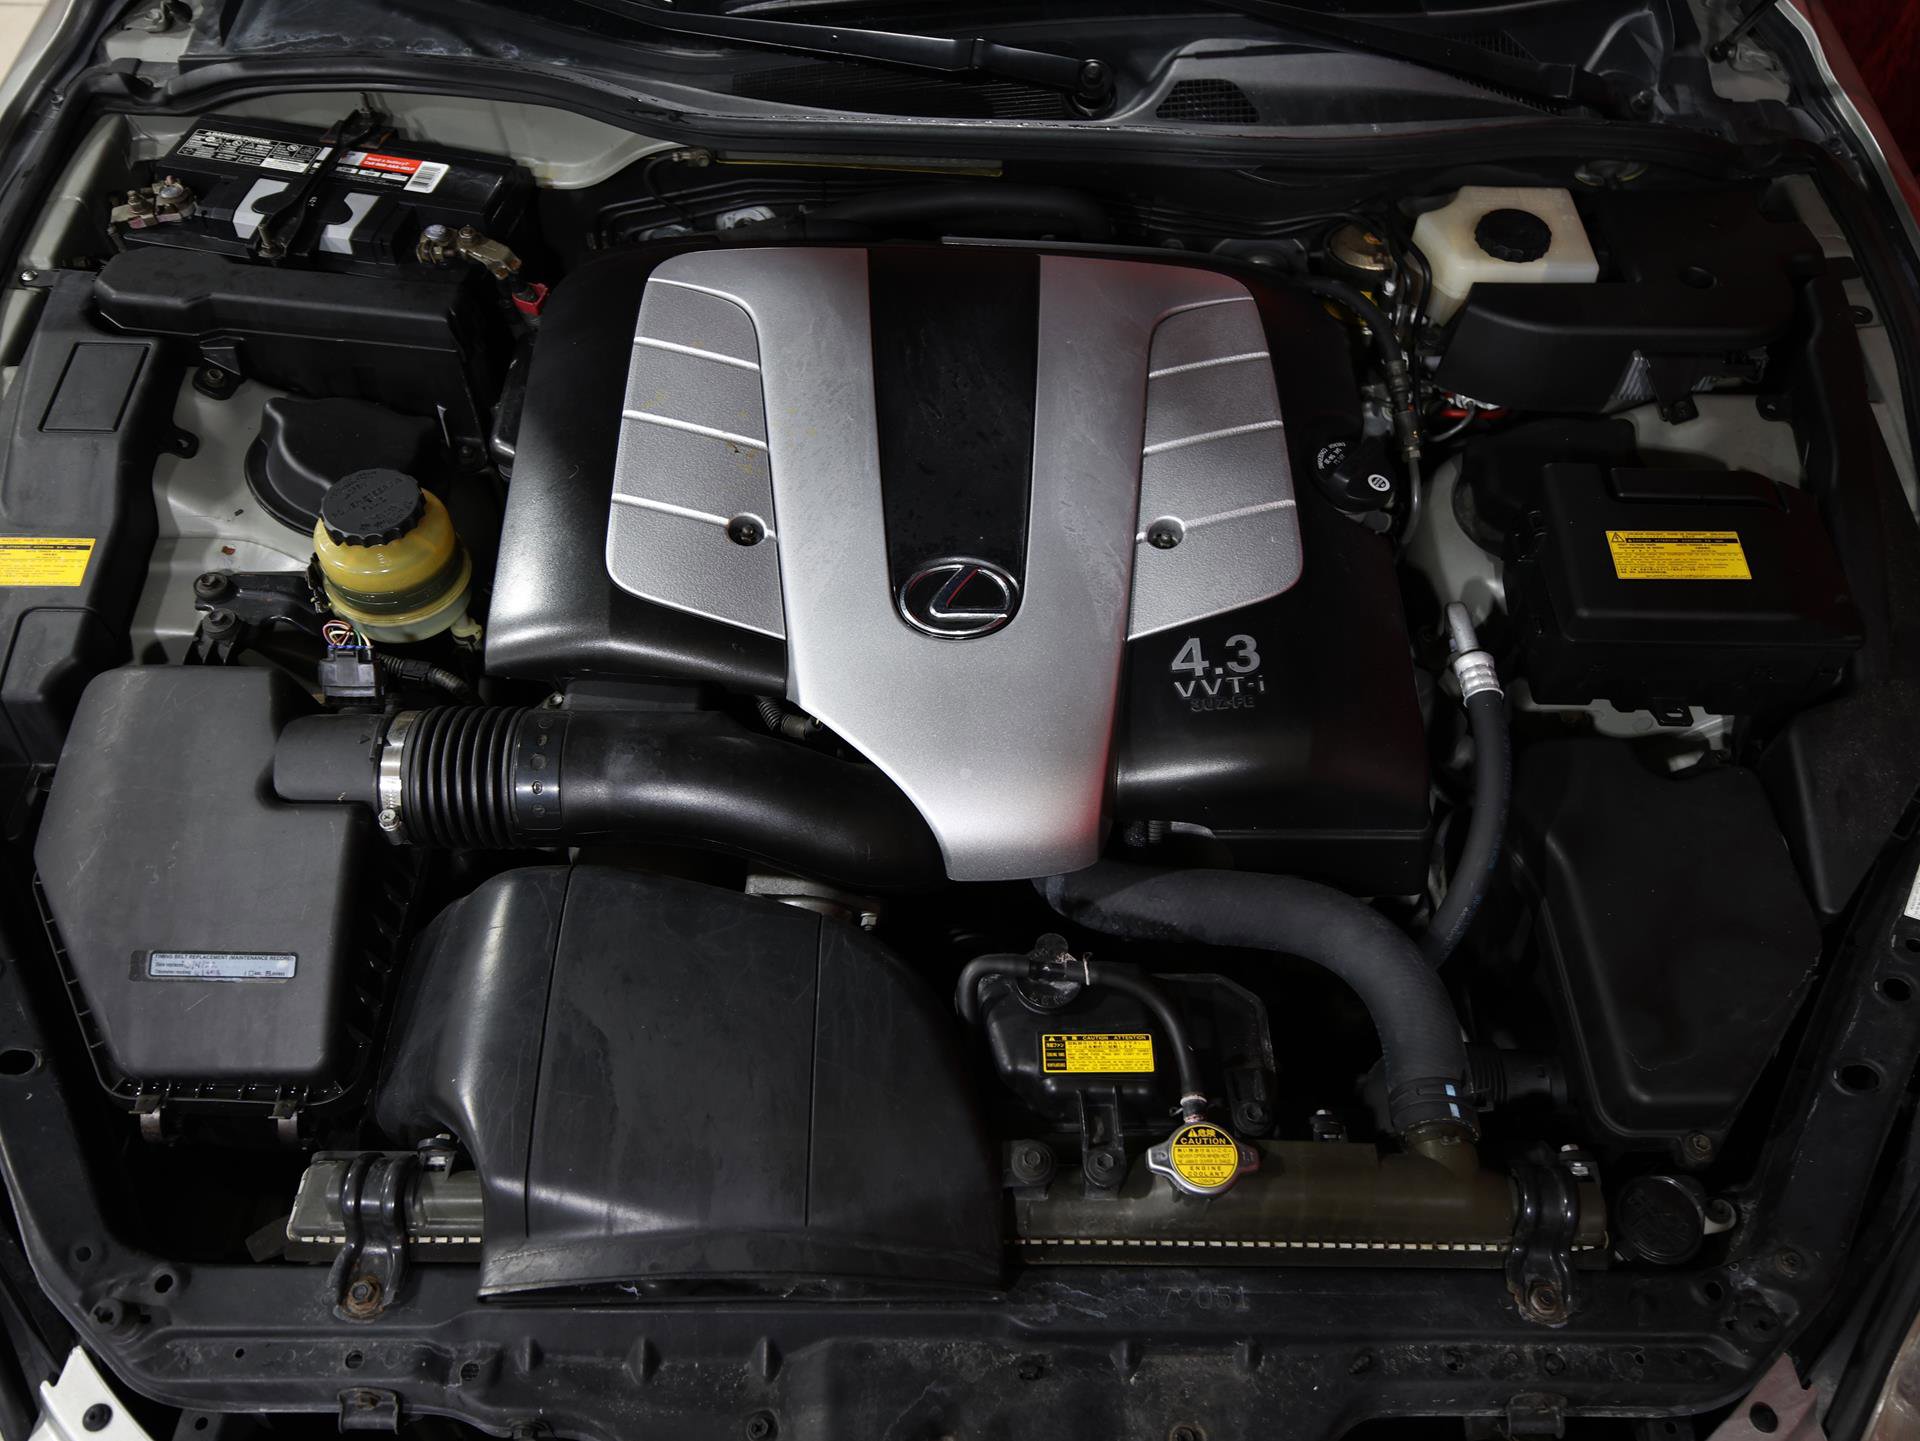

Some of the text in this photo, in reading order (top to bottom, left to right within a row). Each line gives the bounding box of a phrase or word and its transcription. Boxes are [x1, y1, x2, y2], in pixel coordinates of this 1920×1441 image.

[1171, 634, 1262, 677] 4.3
[1174, 675, 1265, 698] VVT-i
[1180, 1137, 1226, 1145] CAUTION
